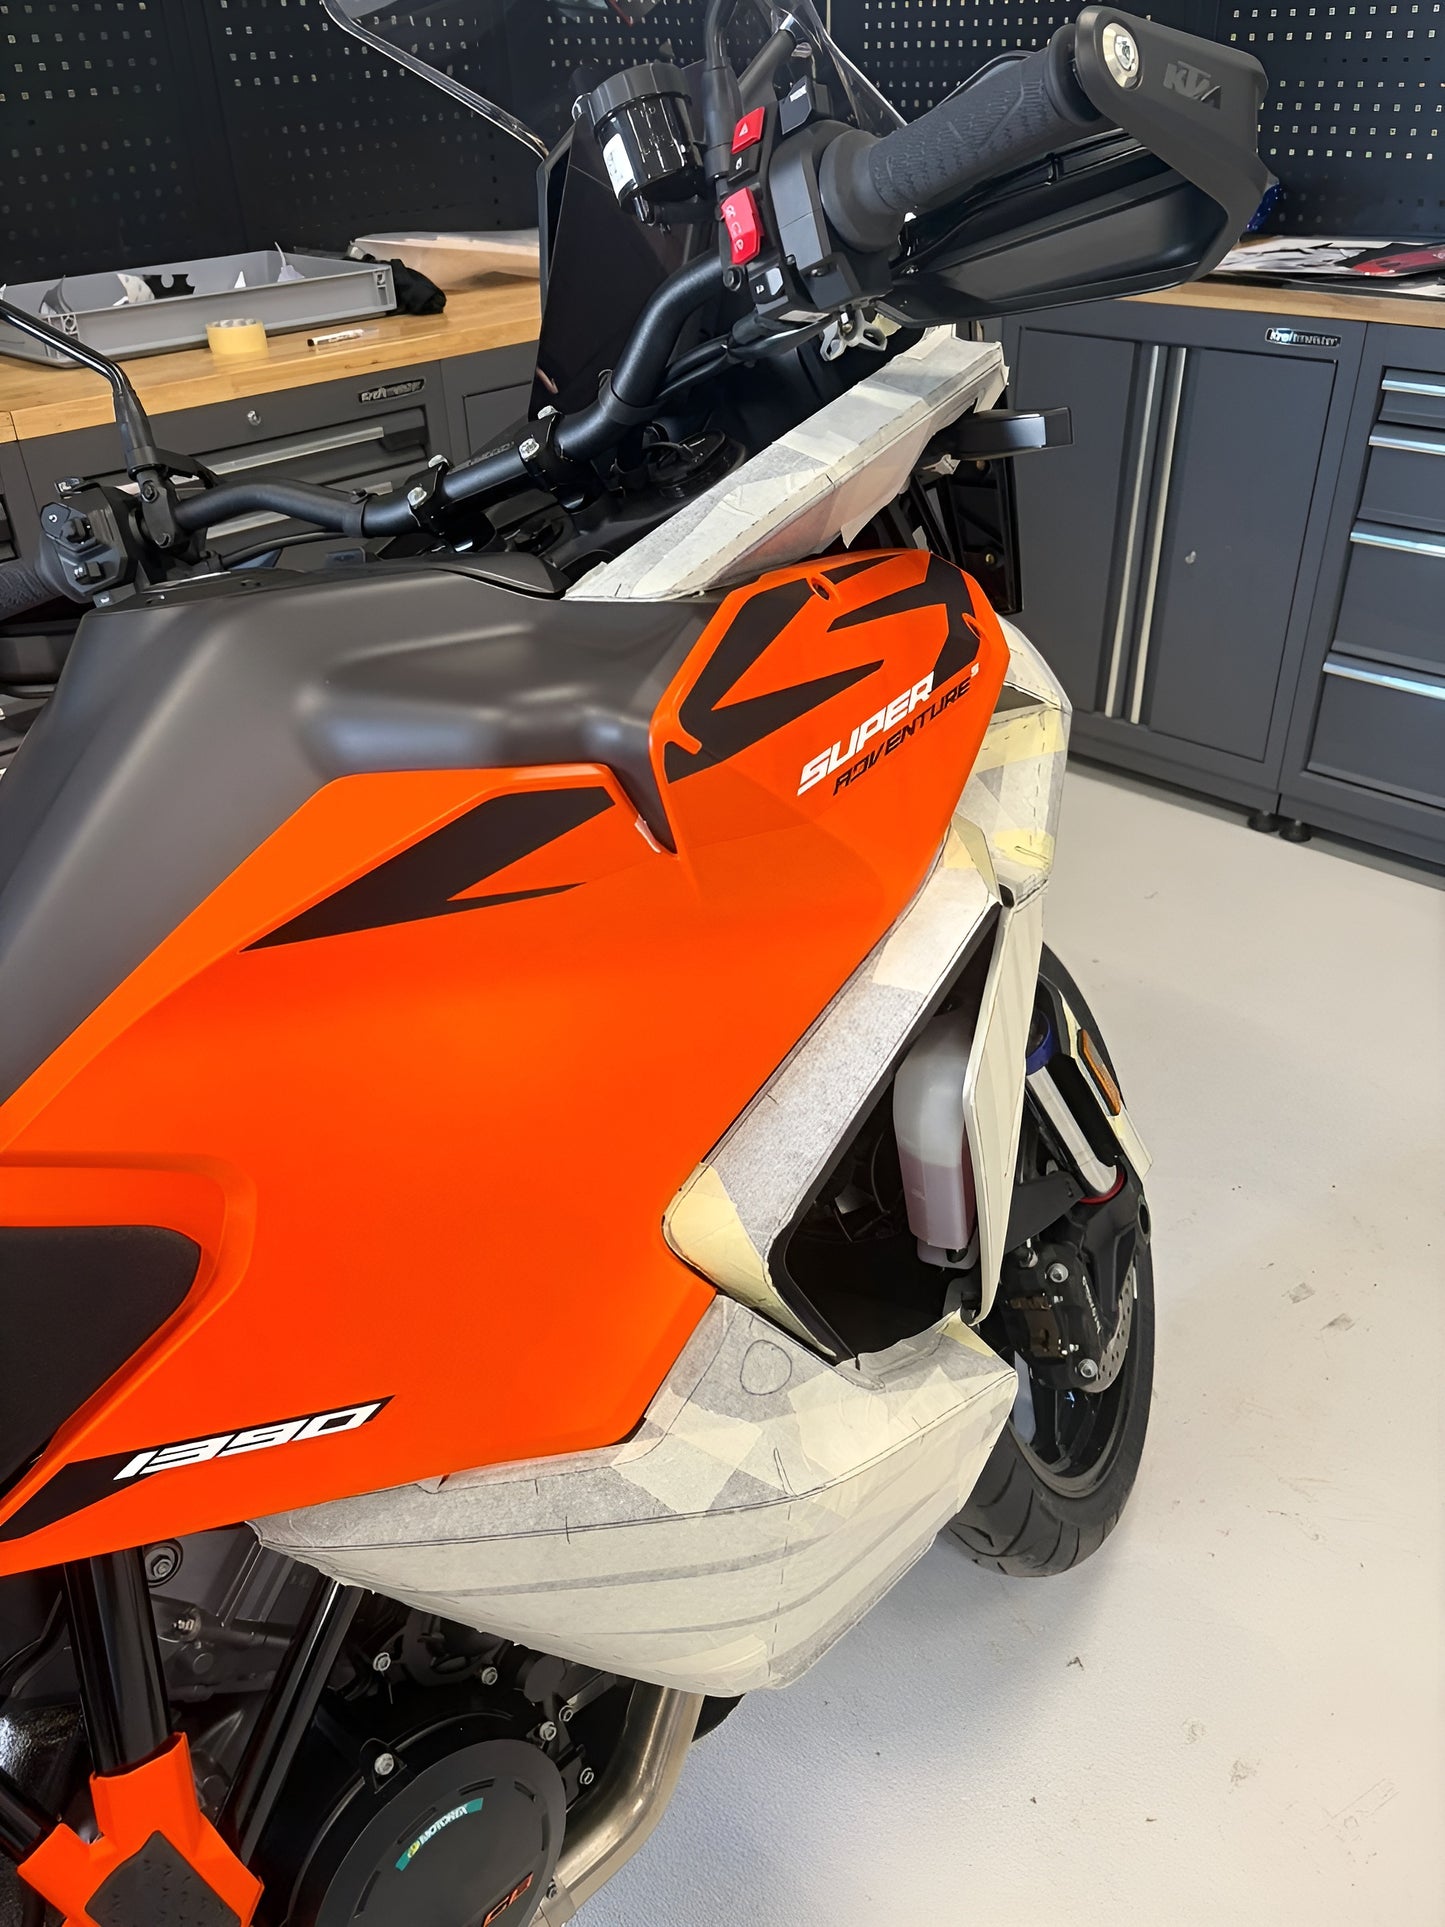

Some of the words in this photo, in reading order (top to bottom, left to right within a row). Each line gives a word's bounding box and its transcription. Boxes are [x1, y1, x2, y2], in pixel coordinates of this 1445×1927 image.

[1163, 60, 1221, 110] KTM
[797, 671, 934, 796] SUPER
[833, 676, 971, 796] ADVENTURE
[113, 1402, 382, 1481] 1390
